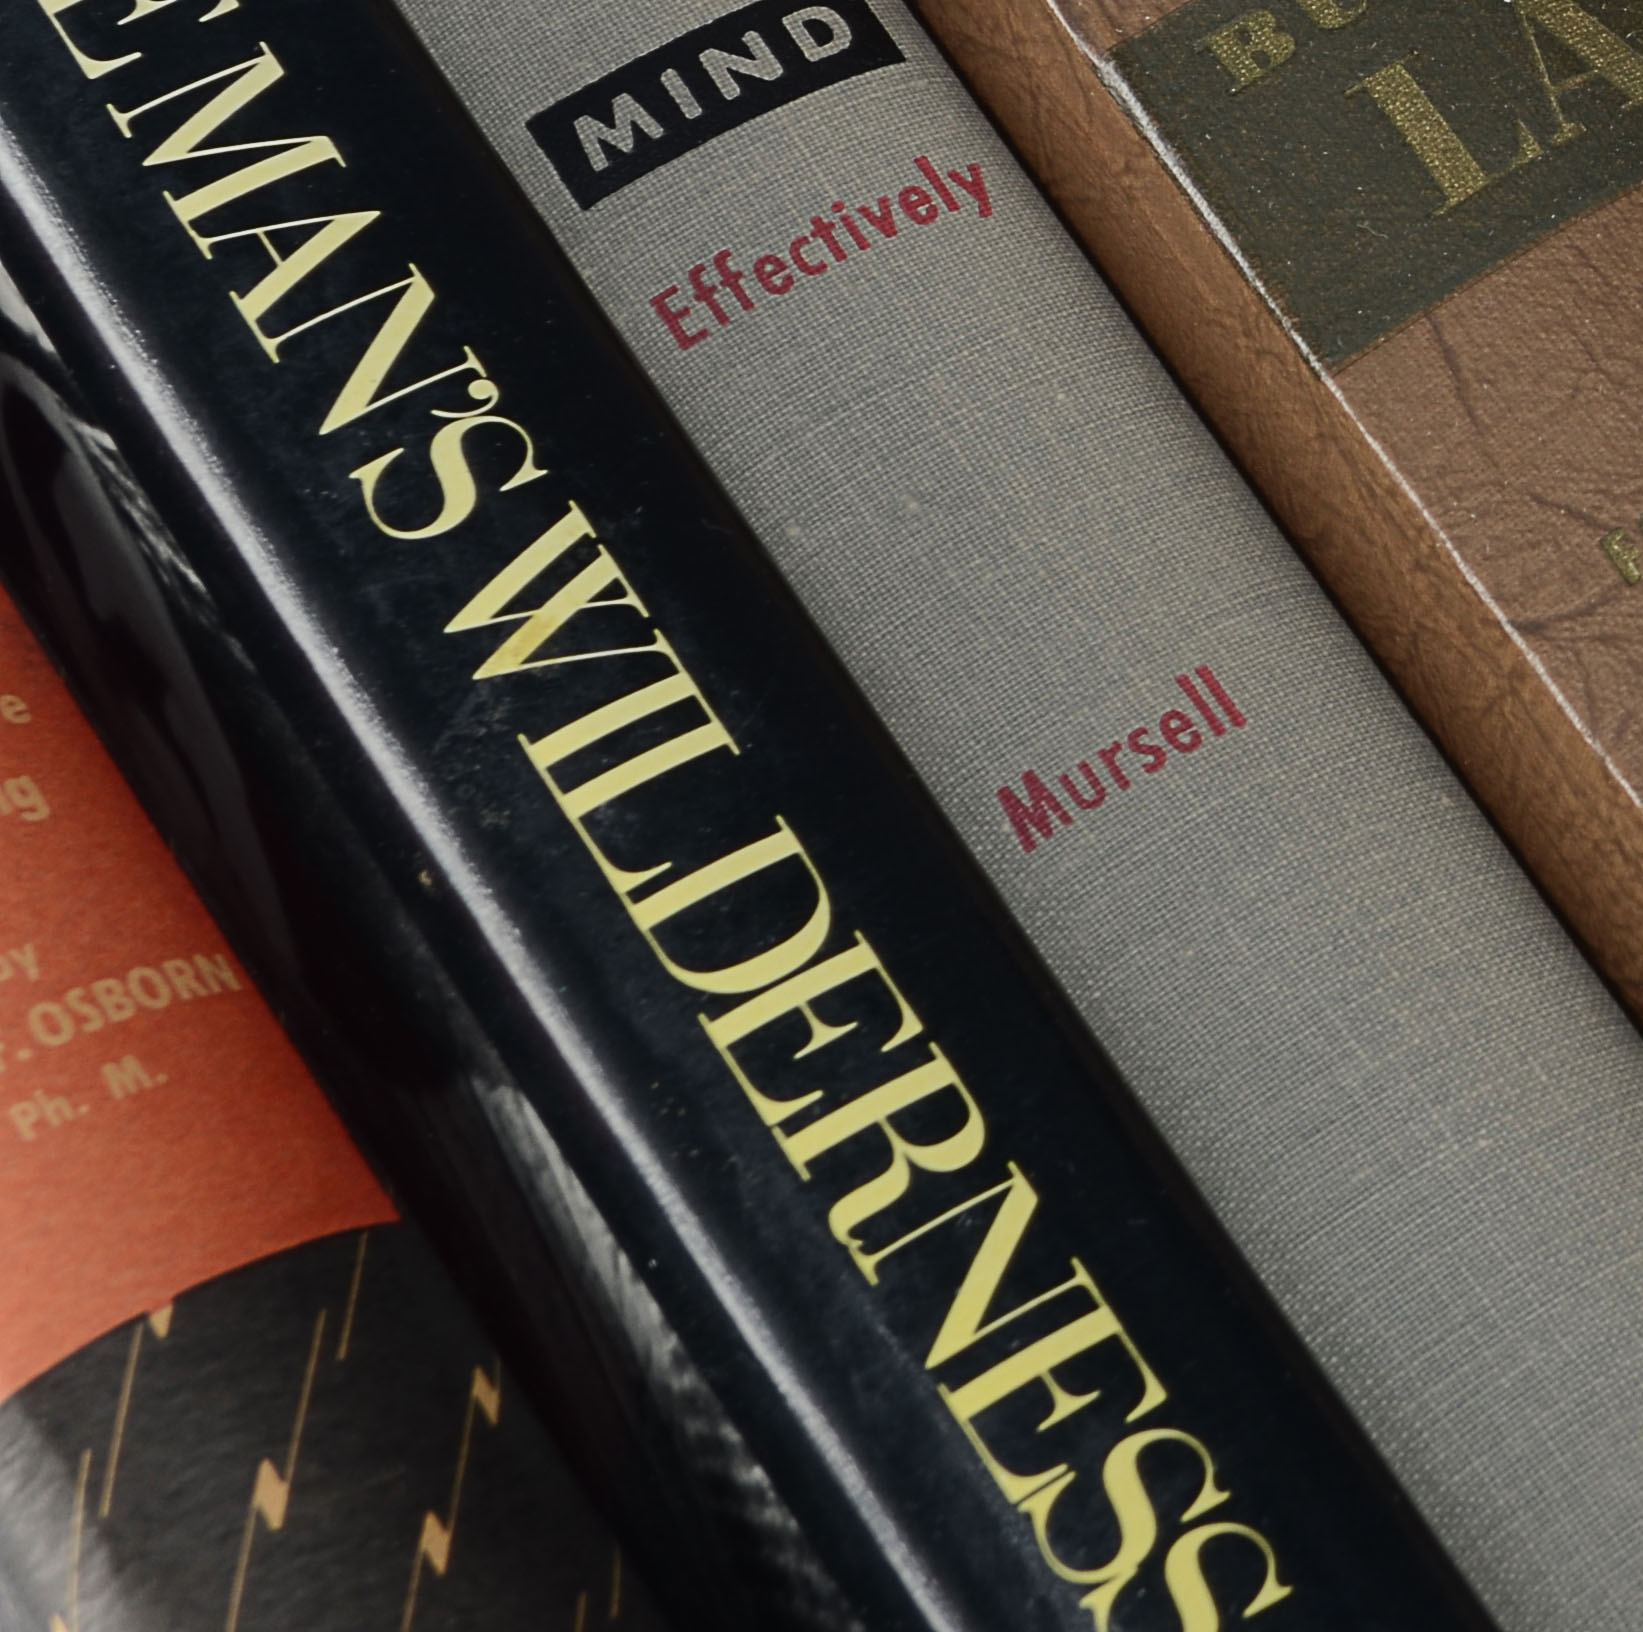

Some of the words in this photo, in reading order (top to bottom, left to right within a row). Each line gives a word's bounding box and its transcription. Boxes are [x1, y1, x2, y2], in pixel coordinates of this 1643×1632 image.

[570, 4, 855, 172] MIND
[648, 155, 994, 352] Effectively
[106, 41, 548, 540] MAN'S
[443, 499, 1293, 1632] WILDERNESS
[996, 665, 1248, 853] Mursell
[28, 952, 242, 1047] OSBORN
[9, 1088, 89, 1141] Ph.
[102, 1054, 168, 1101] M.
